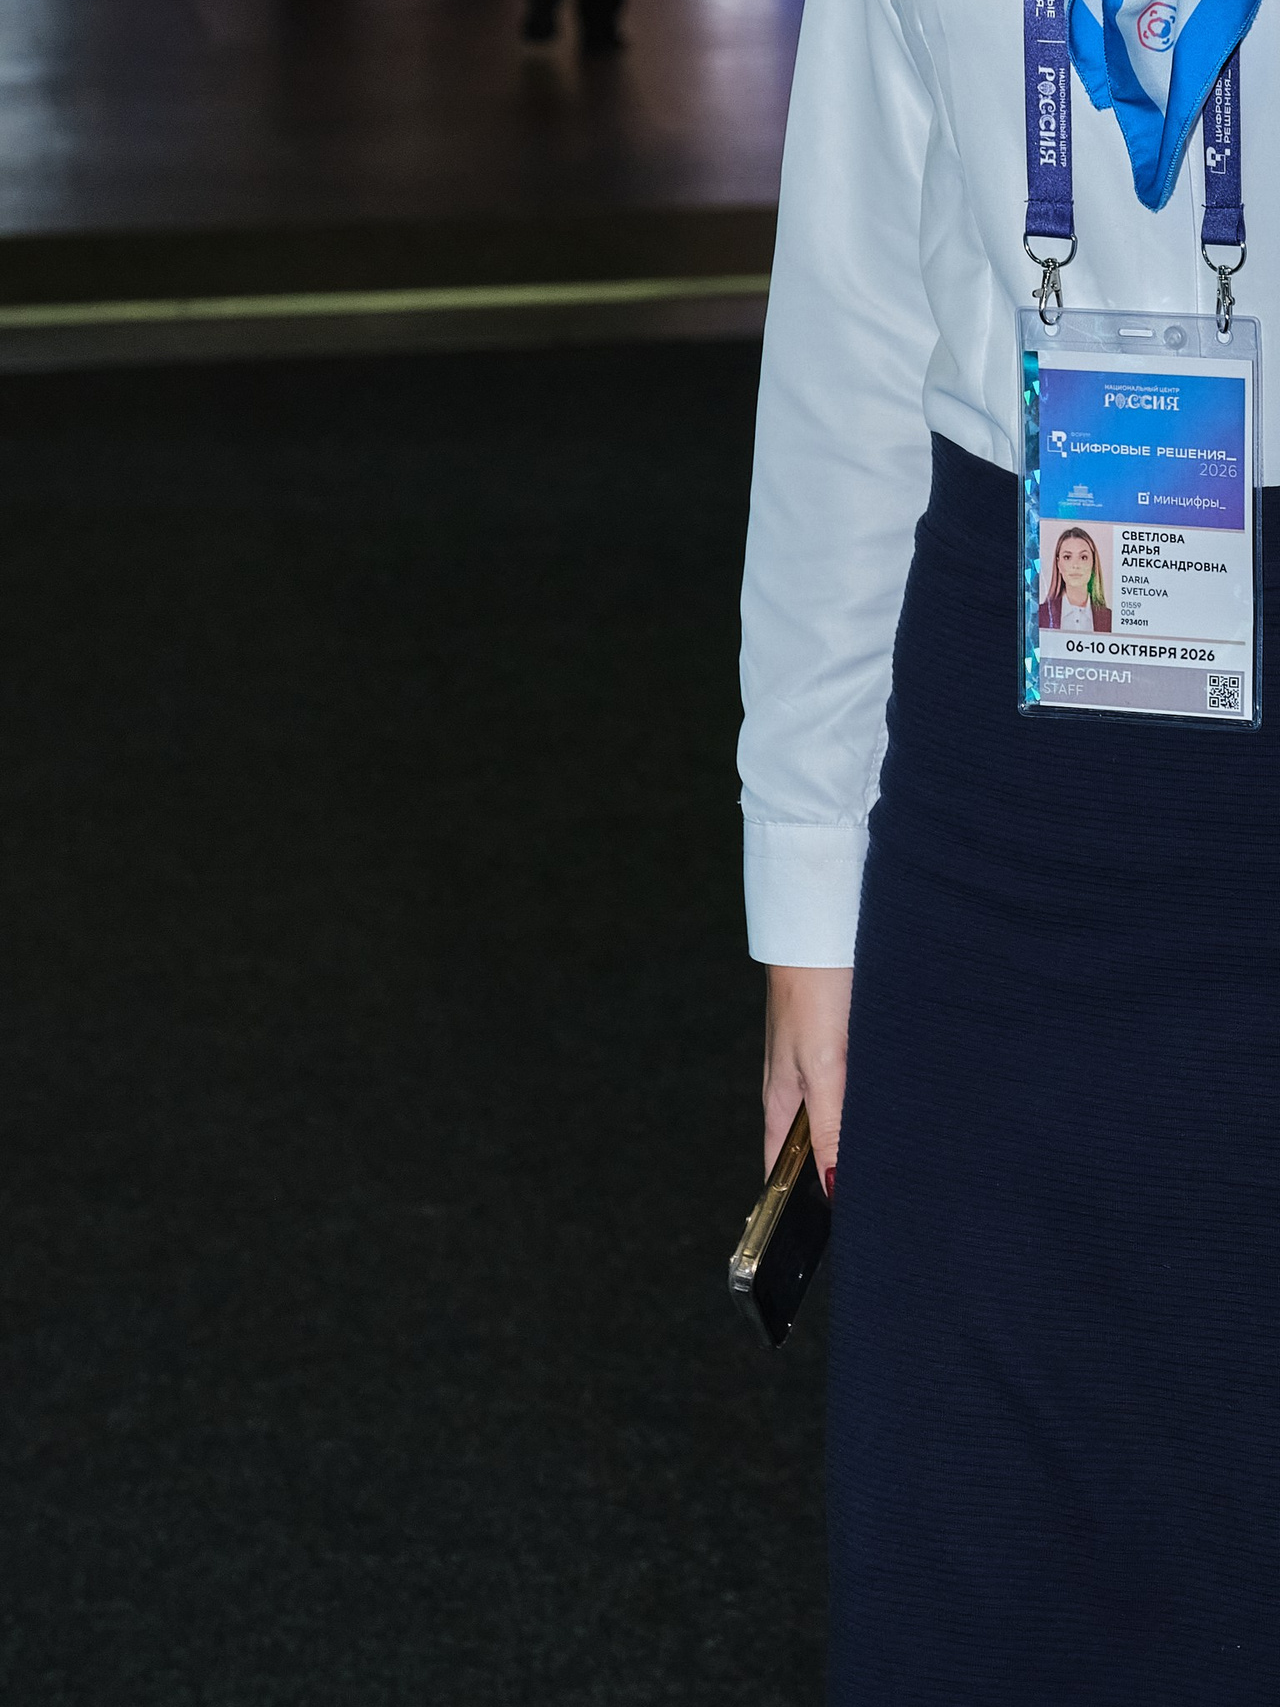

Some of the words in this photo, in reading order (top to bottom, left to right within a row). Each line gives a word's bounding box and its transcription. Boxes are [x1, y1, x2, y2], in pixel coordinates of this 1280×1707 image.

[1059, 68, 1068, 139] НАЦИОНАЛЬНЫЙ
[1215, 77, 1223, 143] ЦИФРОВЫ
[1037, 65, 1057, 167] РОССИЯ
[1059, 140, 1067, 167] ЦЕНТР
[1104, 384, 1159, 393] НАЦИОНАЛЬНЫЙ
[1103, 392, 1180, 411] РОССИЯ
[1070, 442, 1151, 456] ЦИФРОВЫЕ
[1199, 463, 1238, 478] 2026
[1122, 530, 1185, 544] СВЕТЛОВА
[1121, 544, 1160, 555] ДАРЬЯ
[1121, 557, 1228, 573] АЛЕКСАНДРОВНА
[1121, 575, 1150, 584] DARIA
[1121, 587, 1169, 597] SVETLOVA
[1120, 618, 1149, 626] 2934011
[1066, 640, 1105, 654] 06-10
[1108, 643, 1177, 659] ОКТЯБРЯ
[1180, 648, 1215, 662] 2026
[1043, 665, 1132, 683] ПЕРСОНАЛ
[1043, 682, 1084, 696] STAFF
